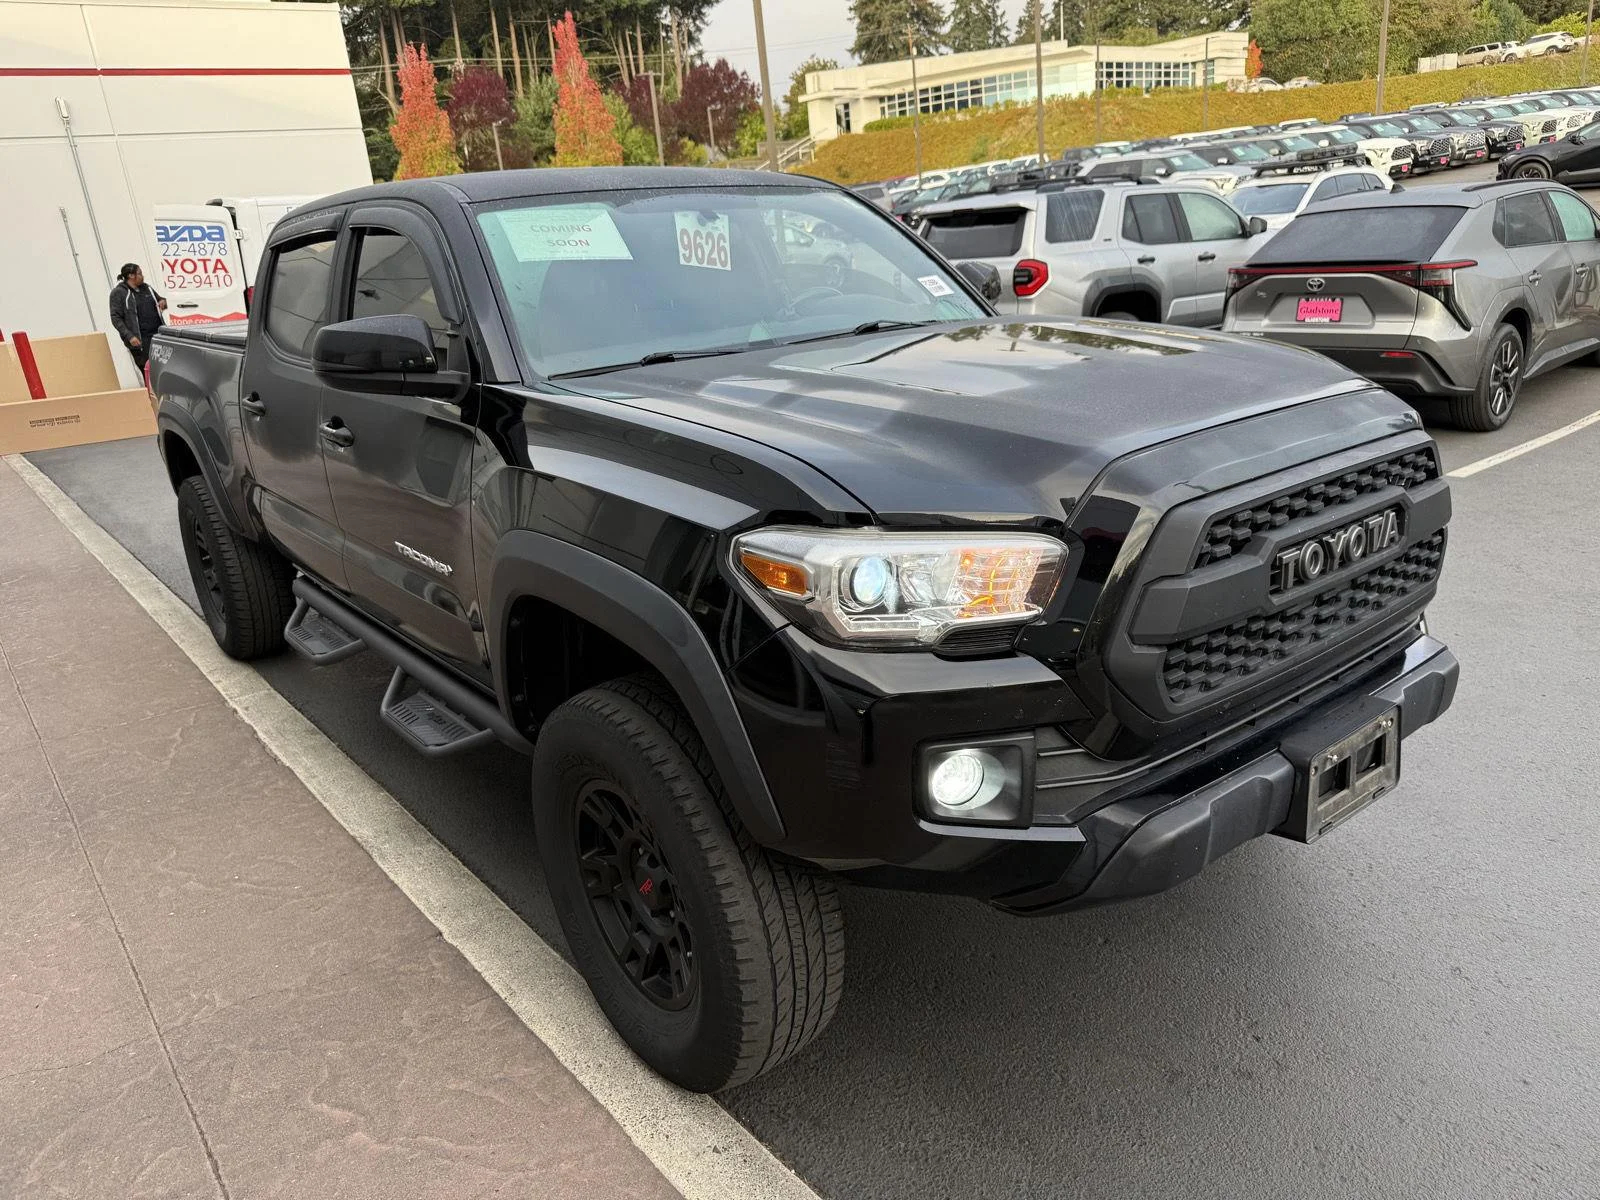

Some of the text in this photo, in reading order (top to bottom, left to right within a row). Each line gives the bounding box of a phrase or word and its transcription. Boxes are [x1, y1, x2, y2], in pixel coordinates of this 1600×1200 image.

[530, 224, 592, 233] COMING
[547, 239, 590, 247] SOON
[680, 228, 729, 268] 9626
[161, 258, 229, 274] YOTA
[164, 274, 233, 289] 52-9410
[1300, 306, 1340, 315] Gladstone
[1276, 509, 1400, 590] TOYOTA
[394, 541, 454, 576] TACOMA
